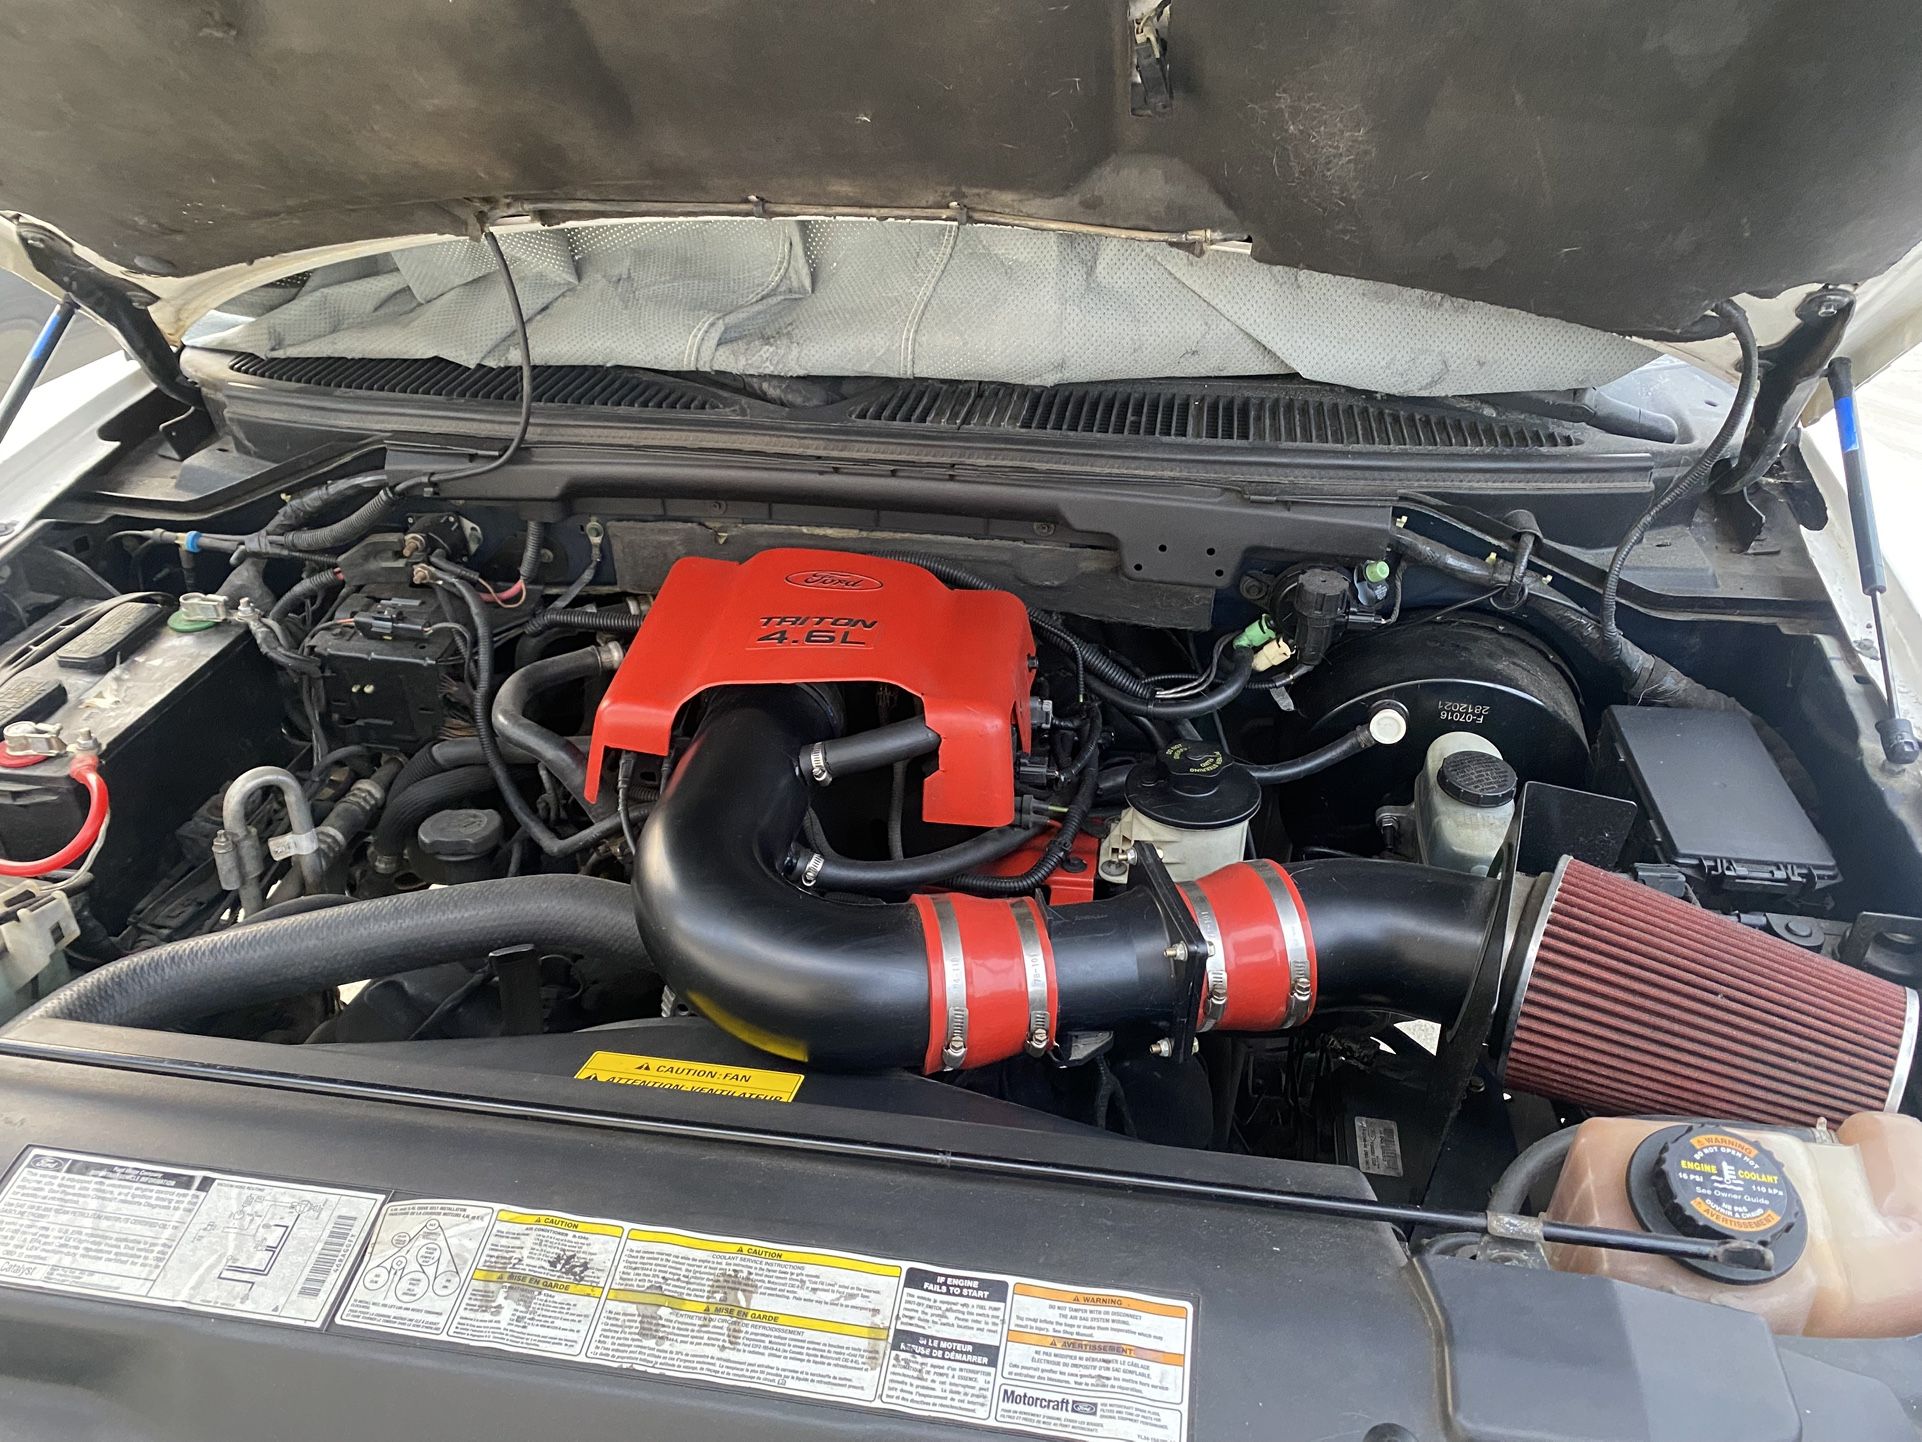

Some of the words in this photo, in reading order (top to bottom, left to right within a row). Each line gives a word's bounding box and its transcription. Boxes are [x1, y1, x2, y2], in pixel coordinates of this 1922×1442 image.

[804, 572, 864, 587] Ford
[760, 616, 878, 630] TRITON
[756, 629, 866, 646] 4.6L
[1438, 700, 1490, 715] 2812021
[1440, 711, 1484, 724] F-07016
[1704, 1136, 1753, 1155] WARNING
[1703, 1146, 1718, 1154] NOT
[1720, 1147, 1742, 1158] OPEN
[1743, 1155, 1760, 1169] HOT
[1680, 1160, 1718, 1174] ENGINE
[1738, 1170, 1779, 1184] COOLANT
[1689, 1174, 1704, 1182] PSI
[1695, 1186, 1712, 1195] See
[1713, 1190, 1742, 1199] Owner
[1743, 1195, 1770, 1205] Guide
[1705, 1199, 1733, 1217] OUVRIR
[544, 1217, 579, 1230] CAUTION
[1703, 1209, 1776, 1229] AVERTISSEMENT
[747, 1247, 783, 1259] CAUTION
[712, 1253, 739, 1262] COOLANT
[739, 1256, 764, 1266] SERVICE
[764, 1261, 806, 1271] INSTRUCTIONS
[528, 1277, 540, 1286] EN
[542, 1281, 571, 1291] GARDE
[936, 1276, 946, 1284] IF
[946, 1277, 979, 1288] ENGINE
[923, 1282, 947, 1293] FAILS
[949, 1286, 961, 1294] TO
[962, 1288, 989, 1299] START
[1083, 1296, 1122, 1306] WARNING
[714, 1306, 735, 1316] MISE
[736, 1309, 749, 1318] EN
[750, 1312, 780, 1323] GARDE
[750, 1324, 805, 1337] REFROIDISSEMENT
[928, 1339, 938, 1347] LE
[939, 1341, 973, 1352] MOTEUR
[944, 1350, 989, 1365] DÉMARRER
[1002, 1389, 1070, 1412] Motorcraft
